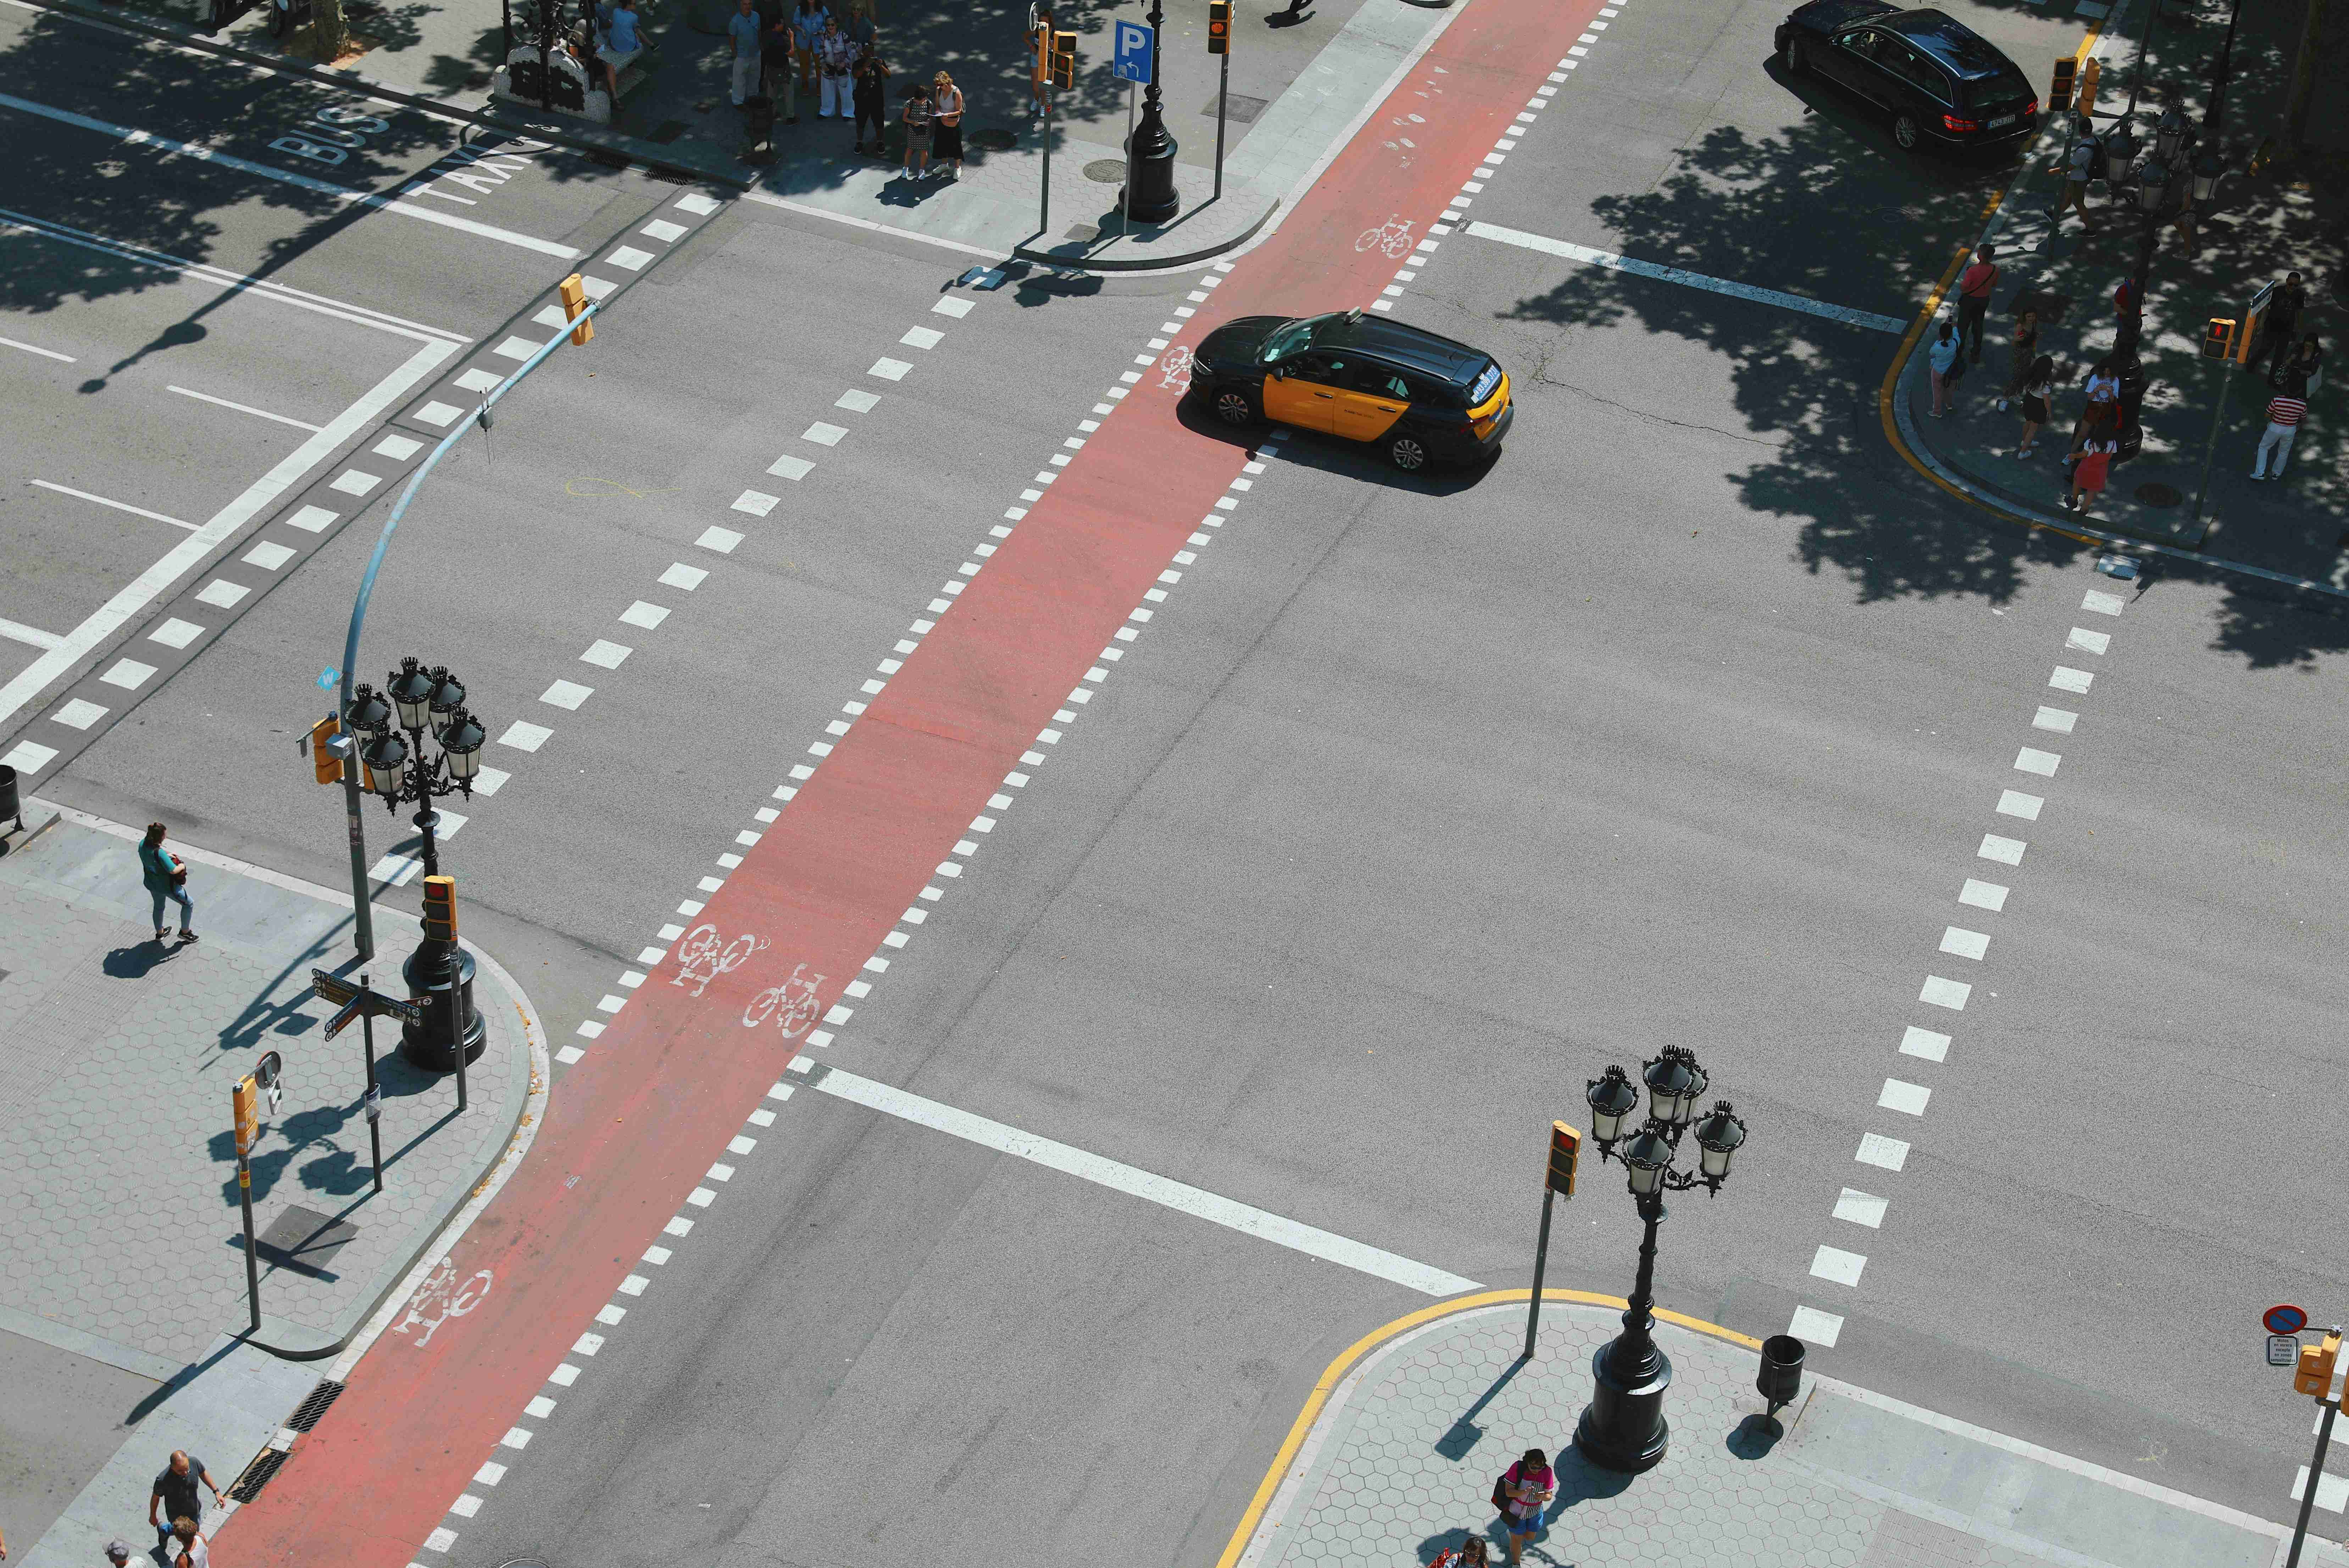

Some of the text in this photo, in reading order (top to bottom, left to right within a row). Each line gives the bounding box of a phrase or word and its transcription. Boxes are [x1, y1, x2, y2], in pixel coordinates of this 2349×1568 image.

[1122, 26, 1145, 56] P
[267, 107, 389, 165] BUS
[399, 143, 533, 205] TAXI
[323, 672, 334, 685] W
